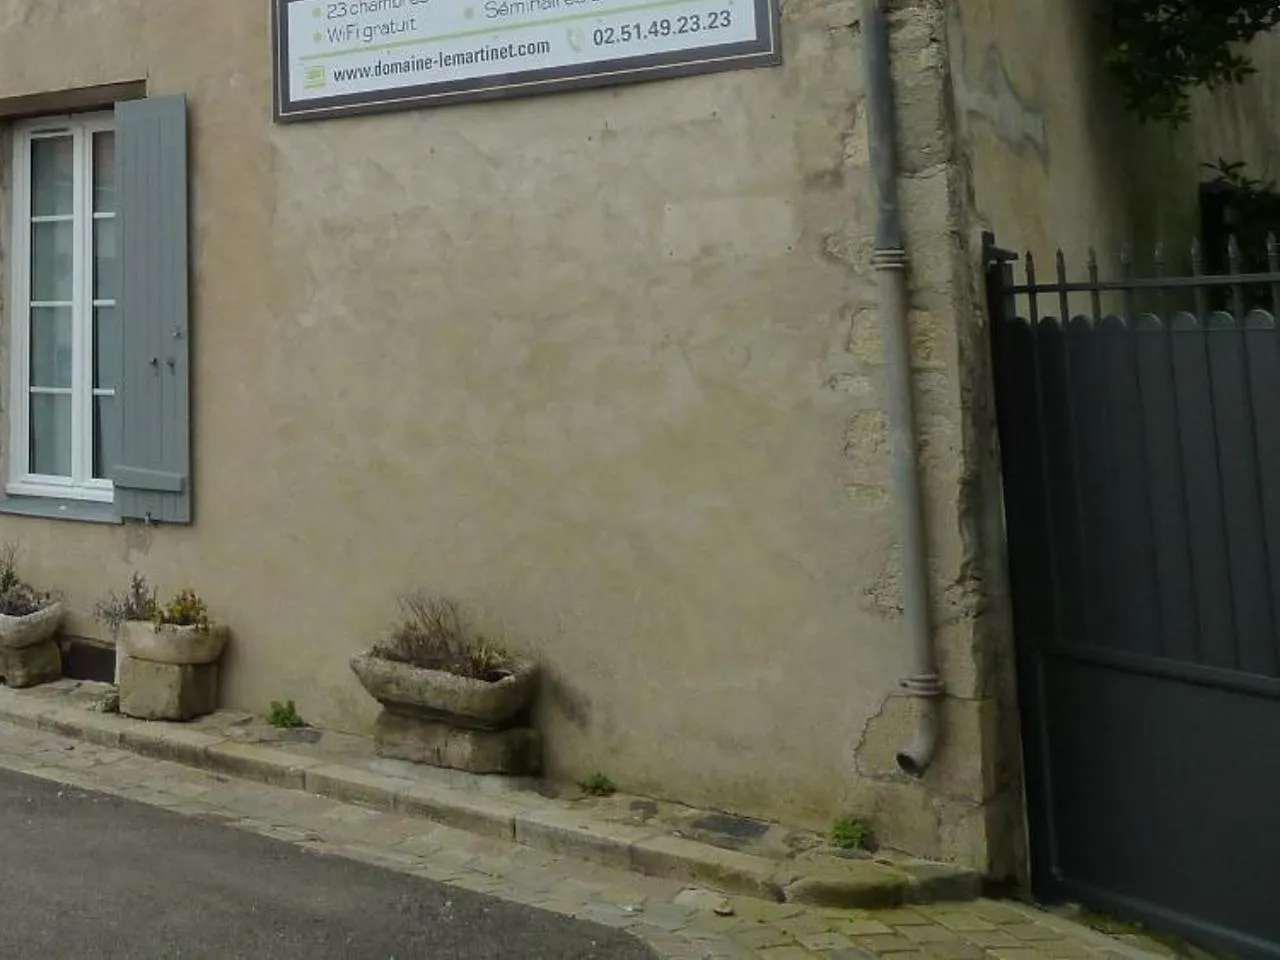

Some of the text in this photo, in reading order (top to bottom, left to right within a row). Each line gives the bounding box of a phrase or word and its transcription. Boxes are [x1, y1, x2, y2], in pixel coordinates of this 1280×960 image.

[326, 2, 348, 19] 23
[363, 17, 417, 43] gratuit
[592, 10, 732, 47] 02.51.49.23.23
[333, 39, 551, 82] www.domaine-lemartinet.com
